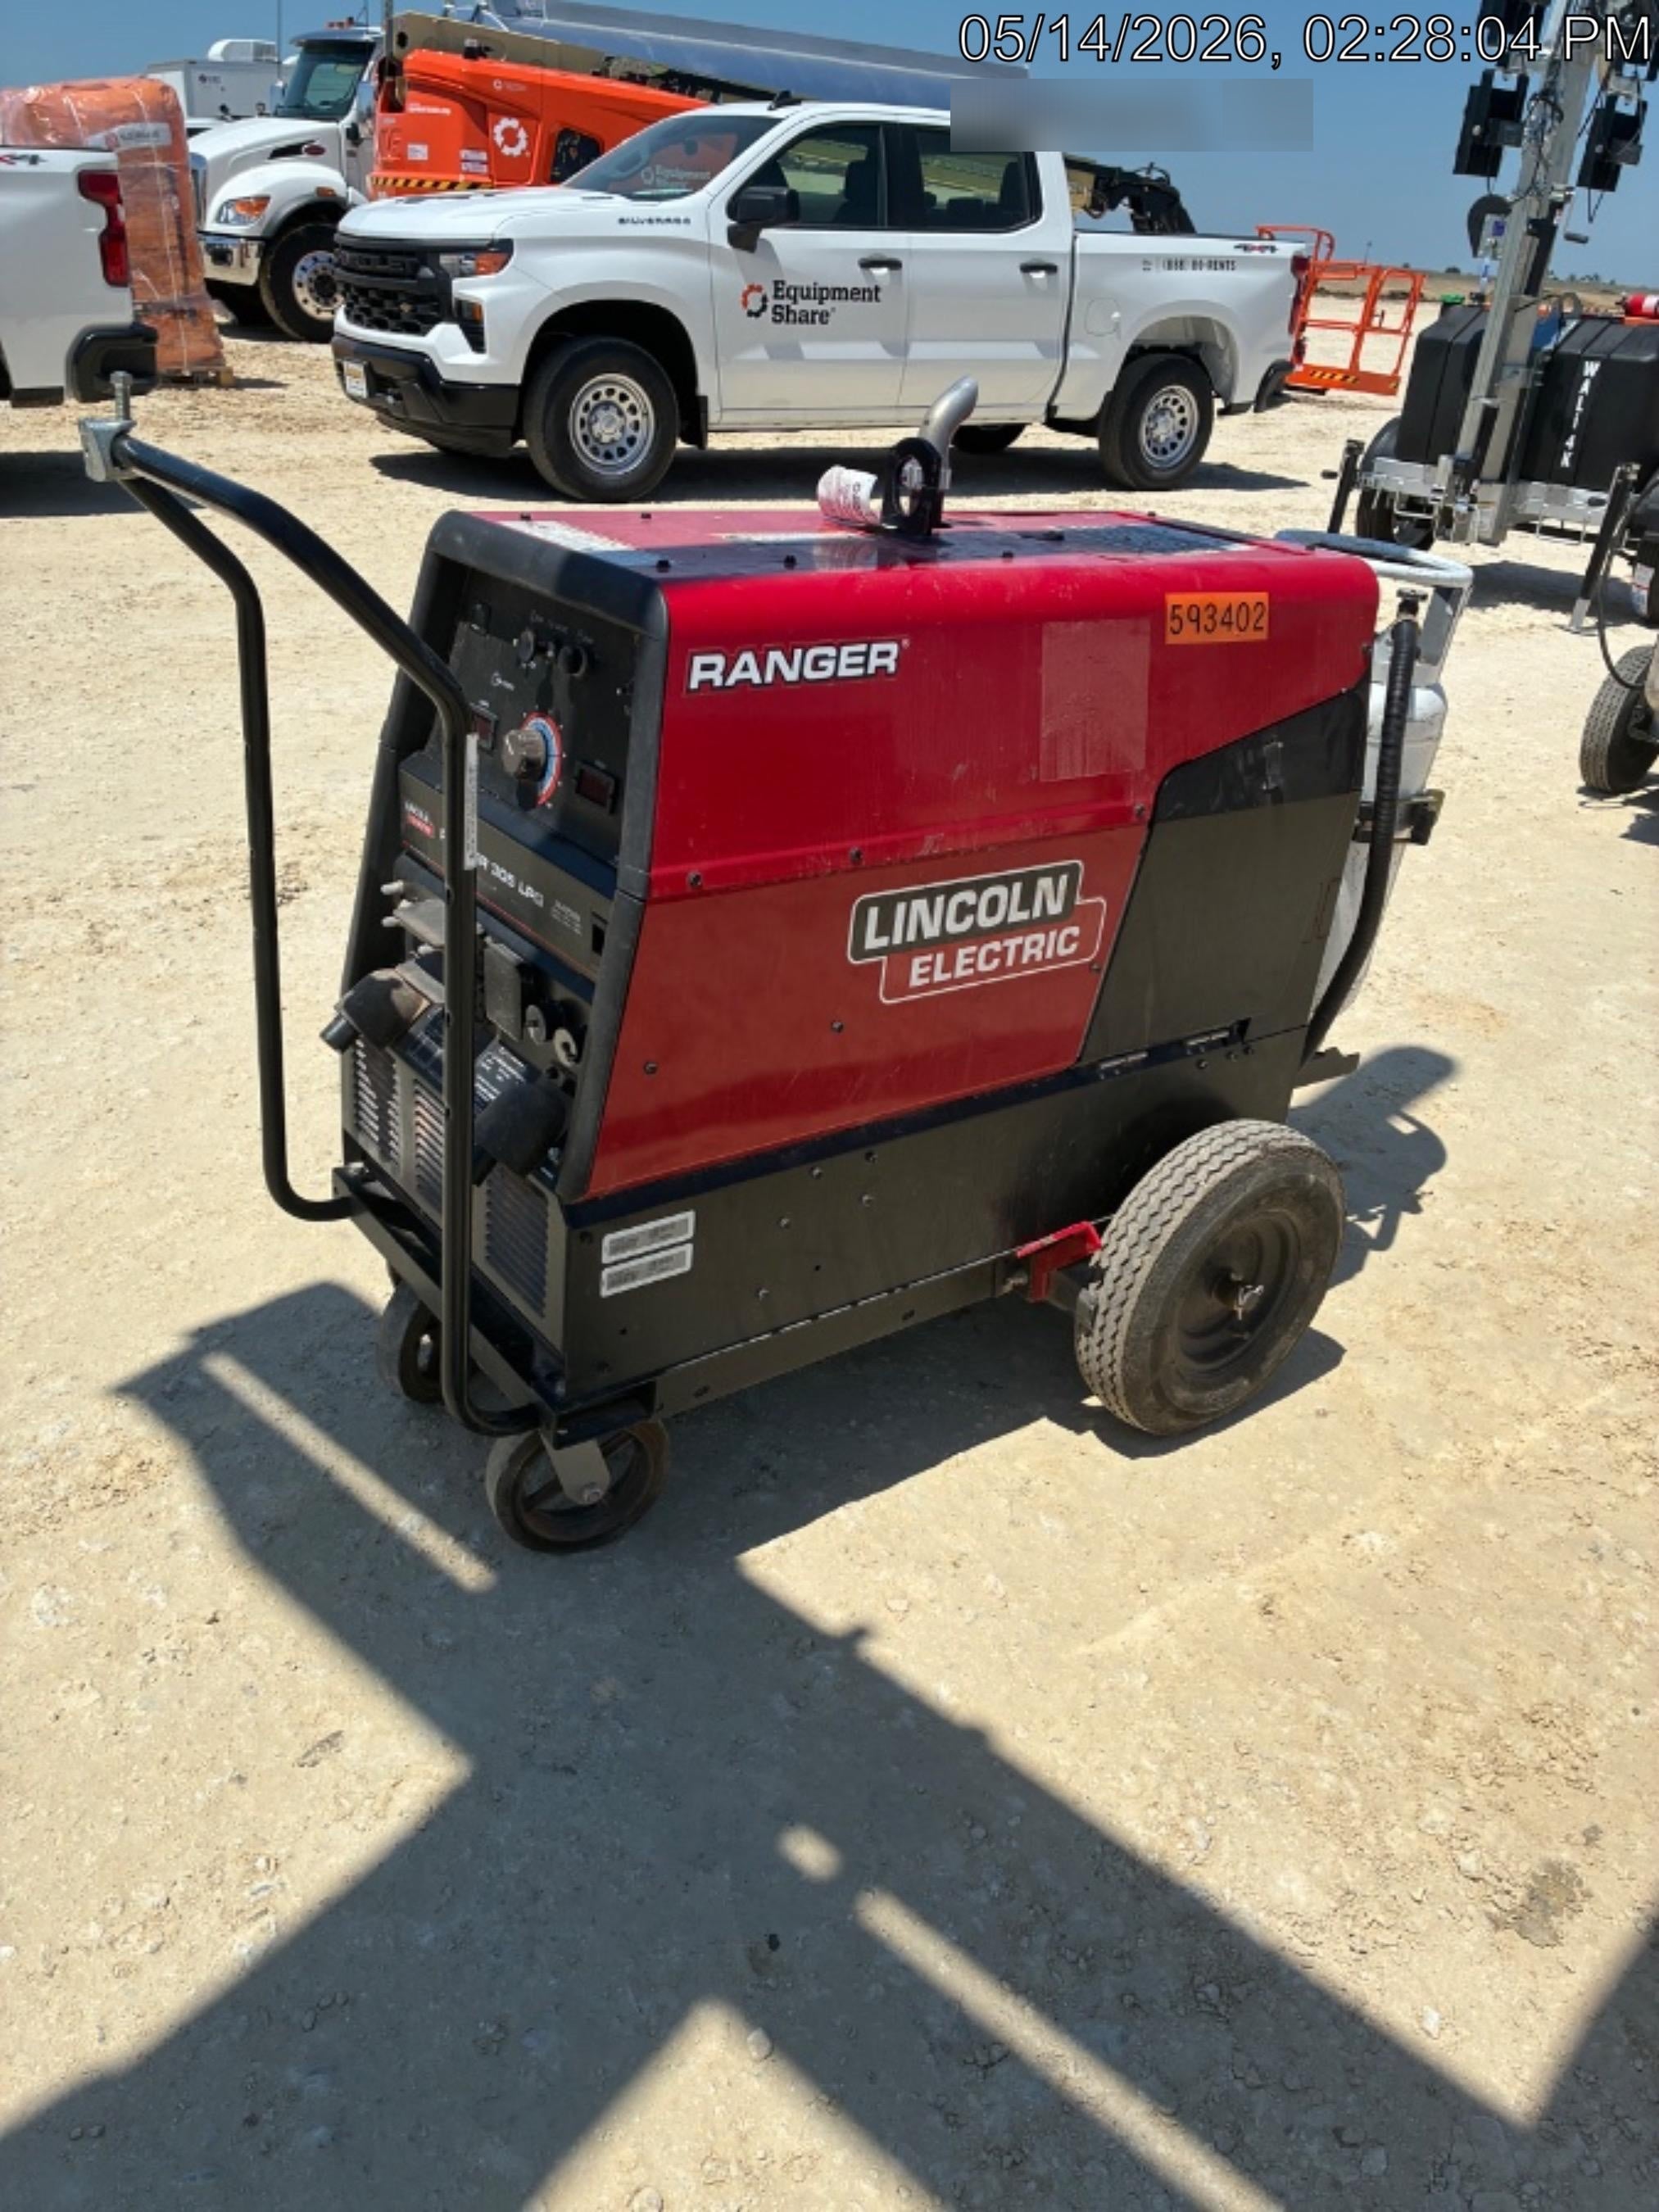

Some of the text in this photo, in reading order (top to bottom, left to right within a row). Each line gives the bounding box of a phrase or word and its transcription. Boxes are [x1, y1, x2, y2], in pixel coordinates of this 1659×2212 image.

[772, 279, 882, 306] Equipment
[771, 304, 831, 325] Share
[1169, 601, 1267, 636] 593402
[689, 641, 900, 691] RANGER
[864, 873, 1069, 951] LINCOLN
[909, 926, 1081, 989] ELECTRIC
